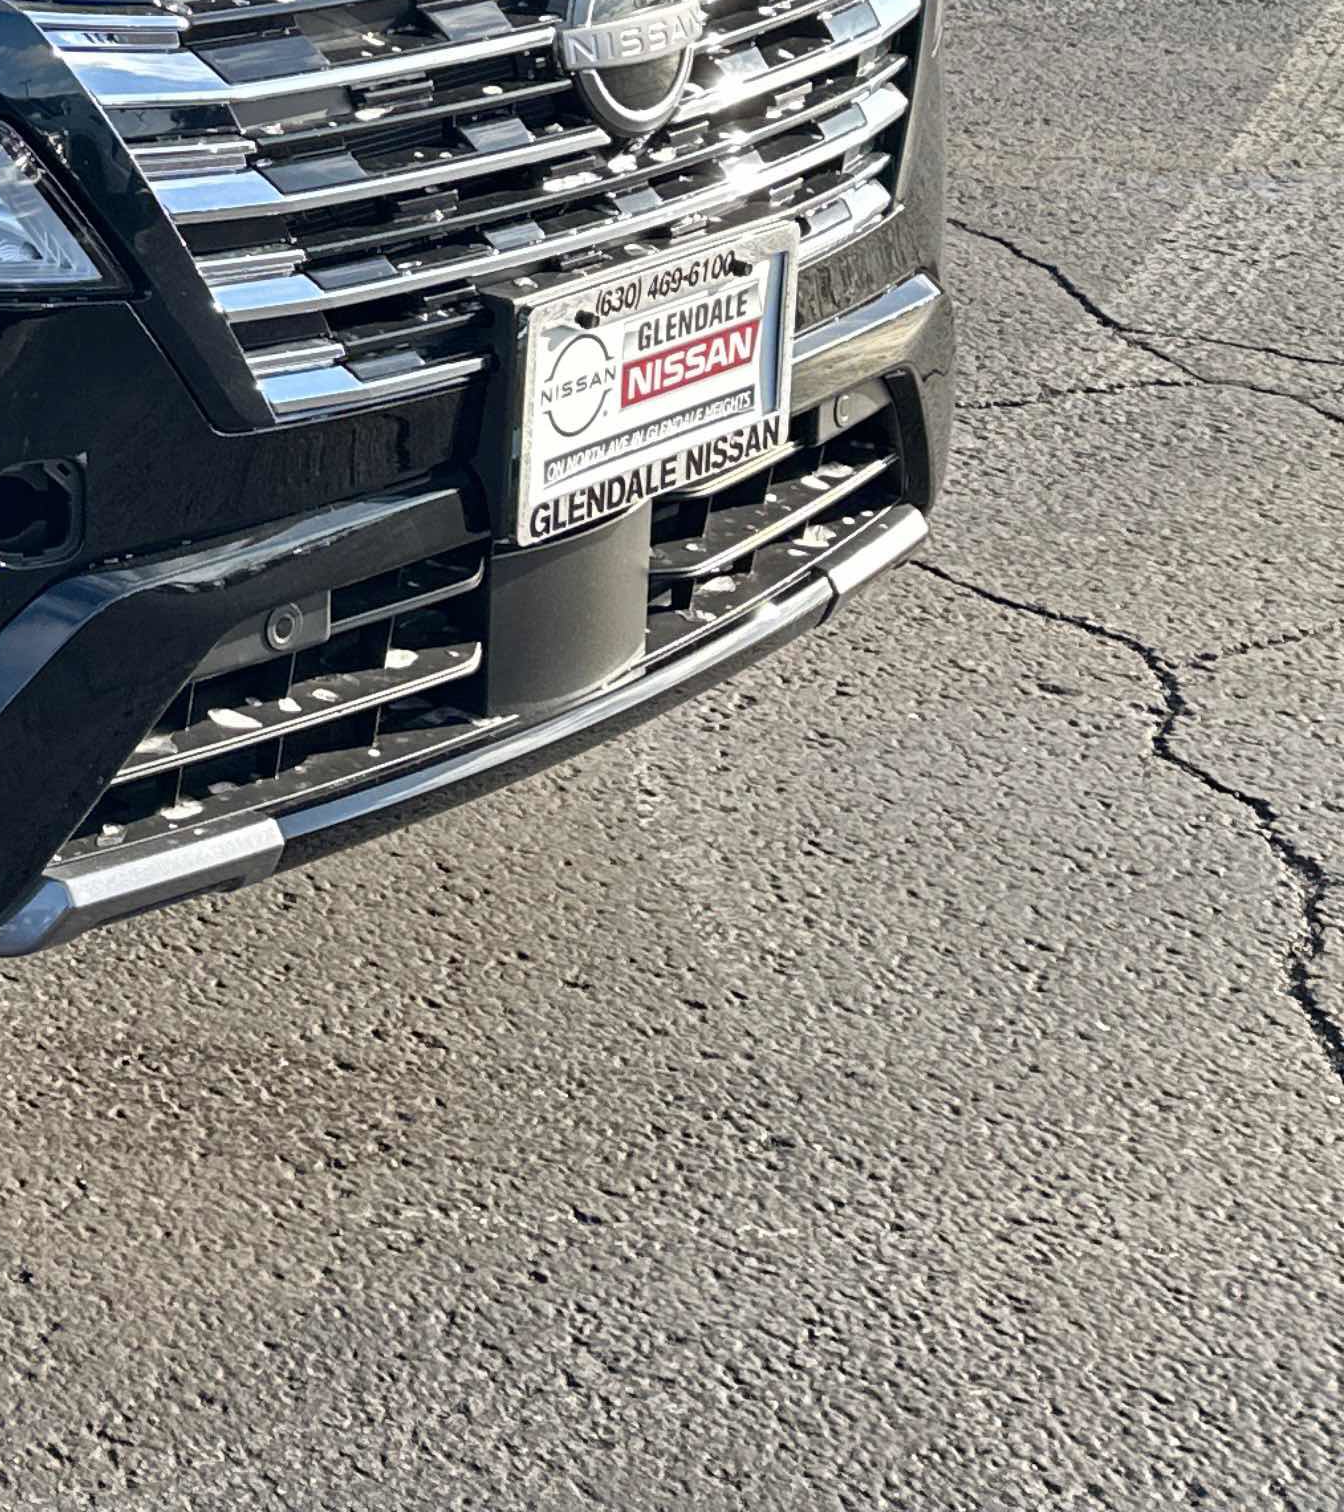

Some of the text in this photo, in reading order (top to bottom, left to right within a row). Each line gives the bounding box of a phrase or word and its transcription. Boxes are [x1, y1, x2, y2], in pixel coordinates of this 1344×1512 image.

[567, 5, 702, 66] NISSAN
[595, 250, 735, 316] (630) 469-6100
[637, 288, 749, 352] GLENDALE
[540, 365, 617, 406] NISSAN
[626, 324, 753, 400] NISSAN
[547, 459, 565, 481] ON
[566, 443, 606, 472] NORTH
[646, 407, 705, 442] GLENDALE
[705, 391, 752, 420] HEIGHTS
[529, 420, 780, 538] GLENDALE NISSAN
